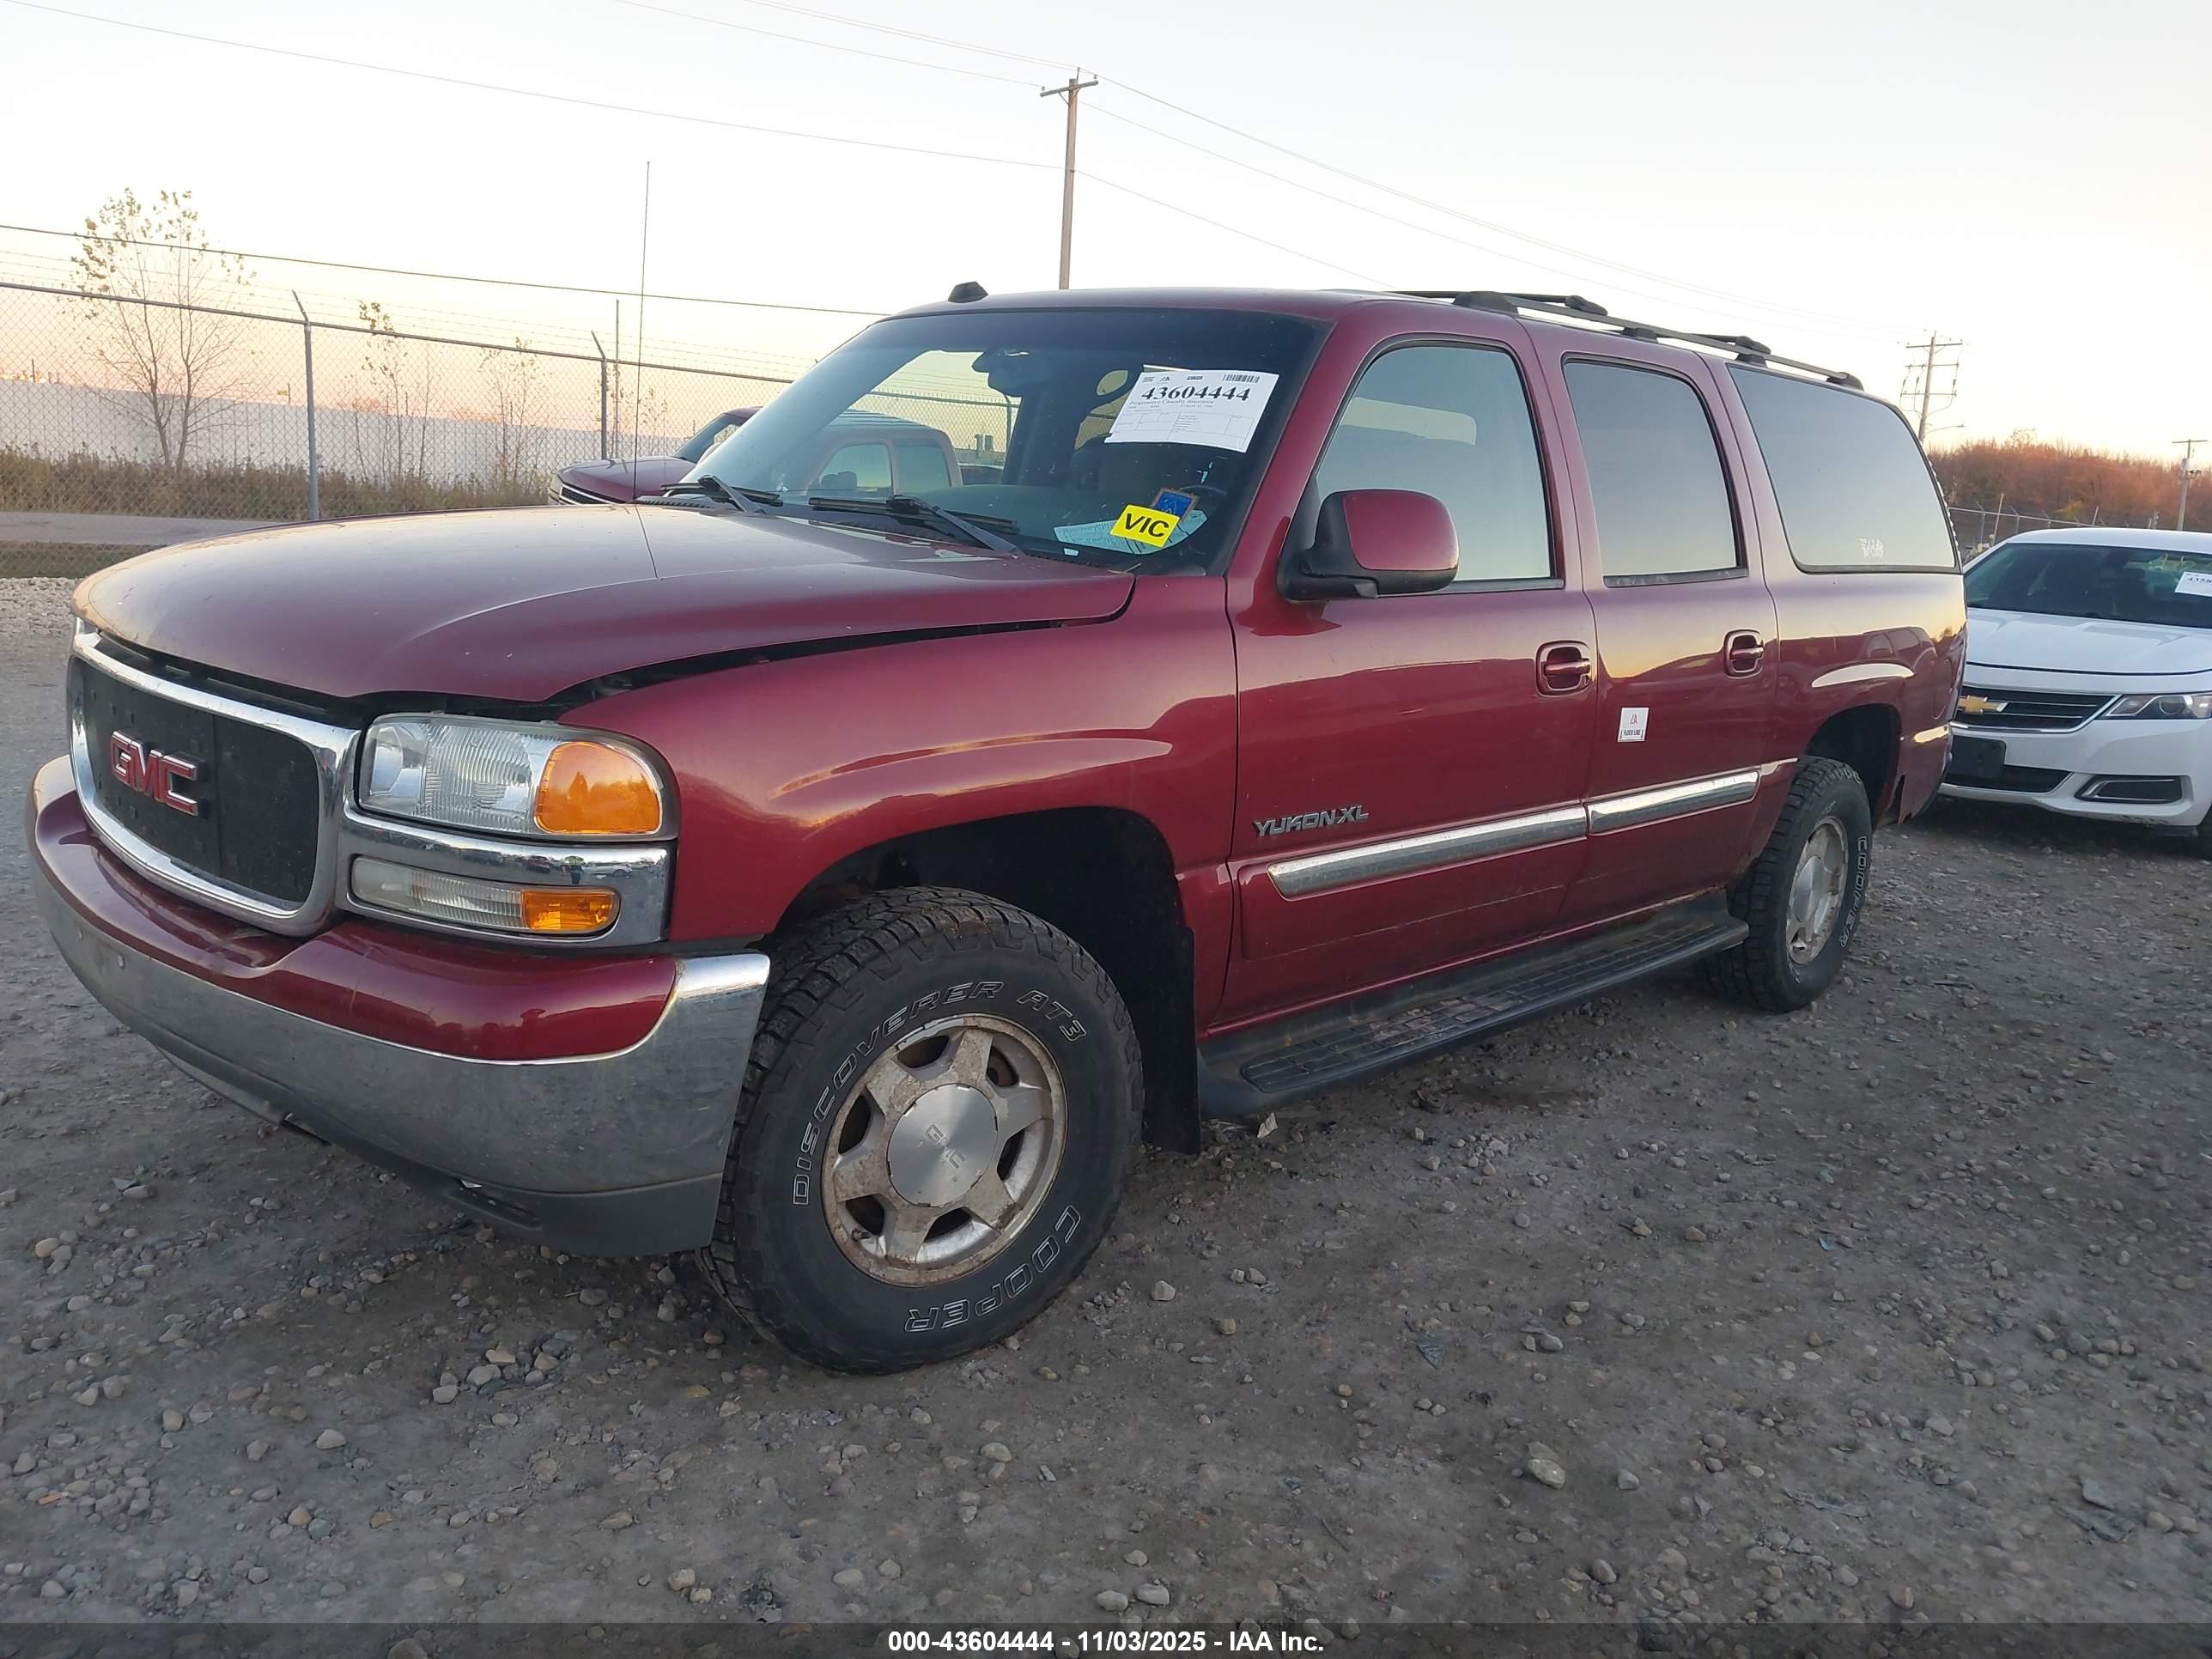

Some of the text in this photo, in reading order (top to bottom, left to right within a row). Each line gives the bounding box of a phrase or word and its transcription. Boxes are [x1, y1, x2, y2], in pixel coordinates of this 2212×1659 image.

[1141, 386, 1249, 401] 43604444
[1125, 513, 1170, 538] VIC
[109, 730, 198, 817] GMC
[1255, 805, 1369, 836] YUKON XL
[1839, 836, 1868, 948] COOPER
[793, 981, 1087, 1206] DISCOVERER AT3
[905, 1205, 1082, 1333] COOPER
